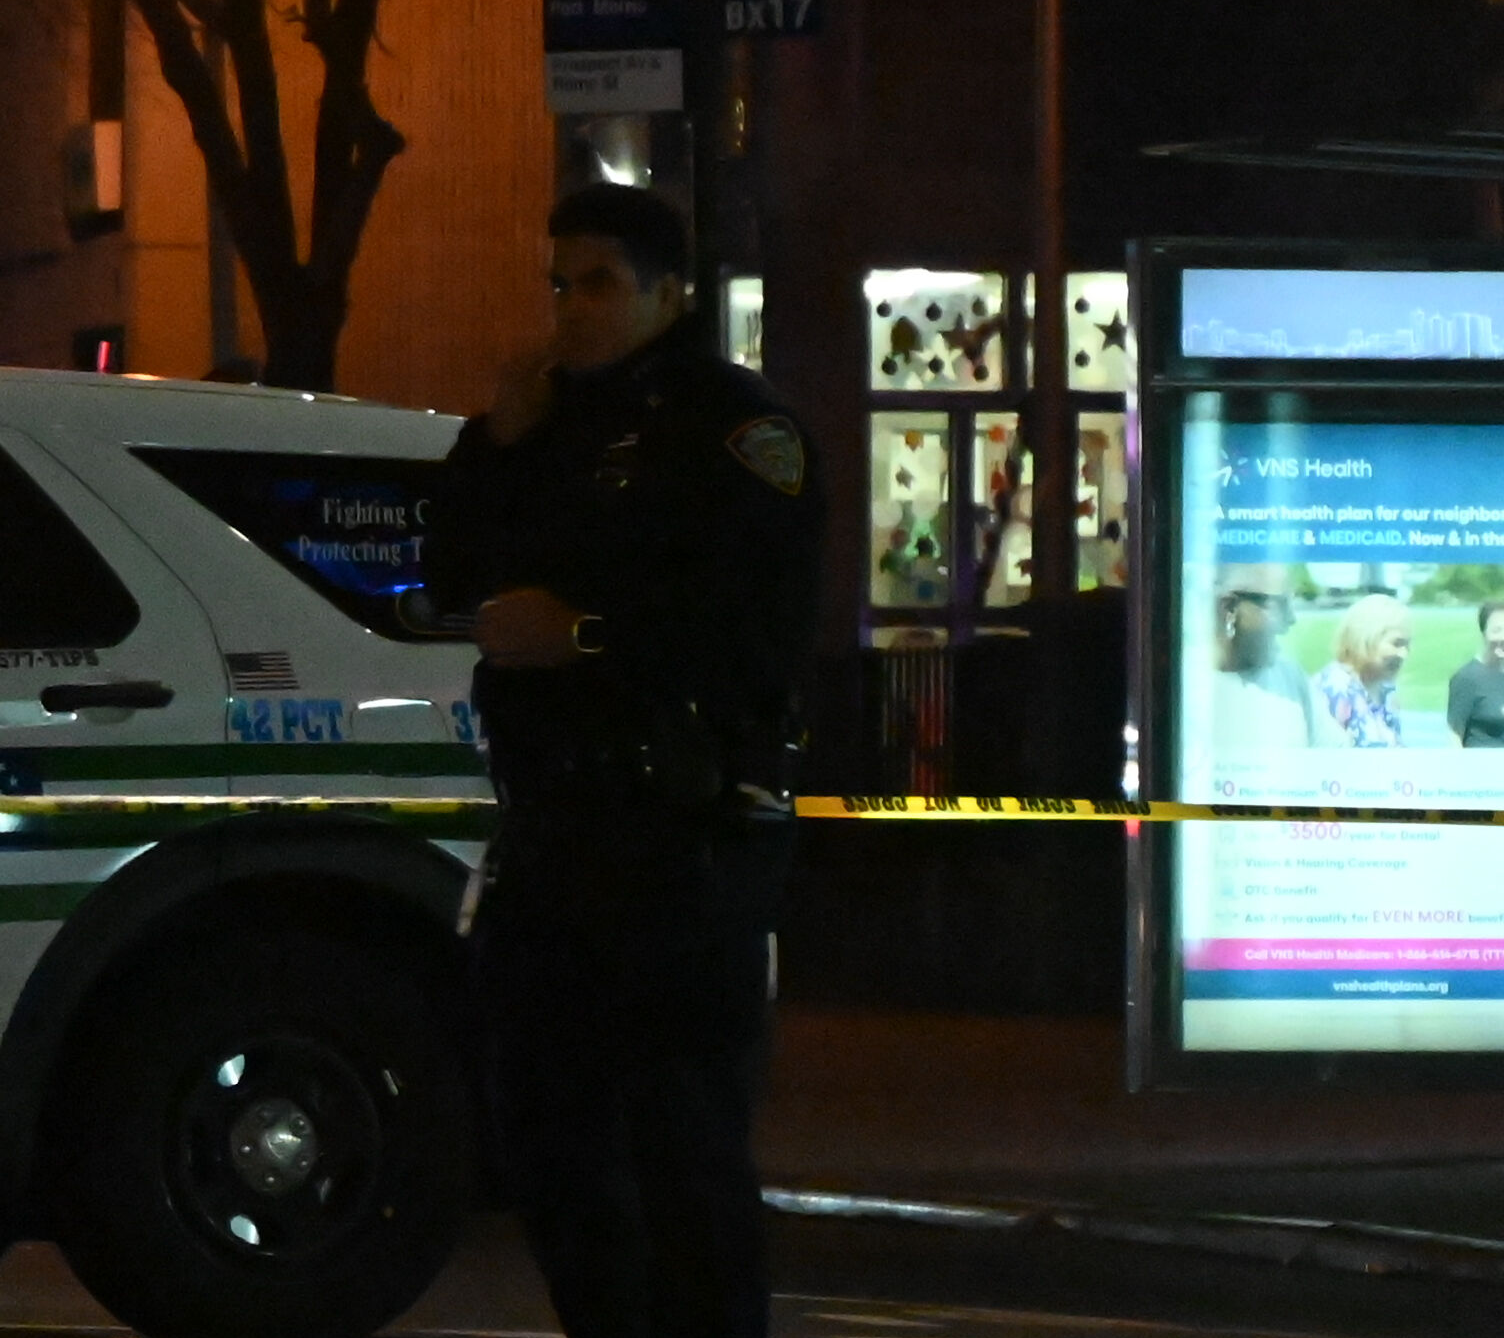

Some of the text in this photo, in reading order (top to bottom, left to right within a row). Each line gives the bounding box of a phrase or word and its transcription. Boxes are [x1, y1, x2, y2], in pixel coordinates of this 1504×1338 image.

[1255, 458, 1373, 478] VNS Health
[322, 498, 407, 530] Fighting
[1228, 507, 1278, 521] smart
[1281, 504, 1335, 521] health
[1337, 506, 1374, 523] plan
[1375, 505, 1400, 521] for
[1401, 508, 1431, 521] our
[1303, 530, 1316, 545] &
[1409, 530, 1446, 546] Now
[1448, 529, 1461, 546] &
[297, 534, 402, 566] Protecting
[281, 698, 344, 742] PCT
[1372, 909, 1414, 924] EVEN
[1417, 909, 1465, 924] MORE
